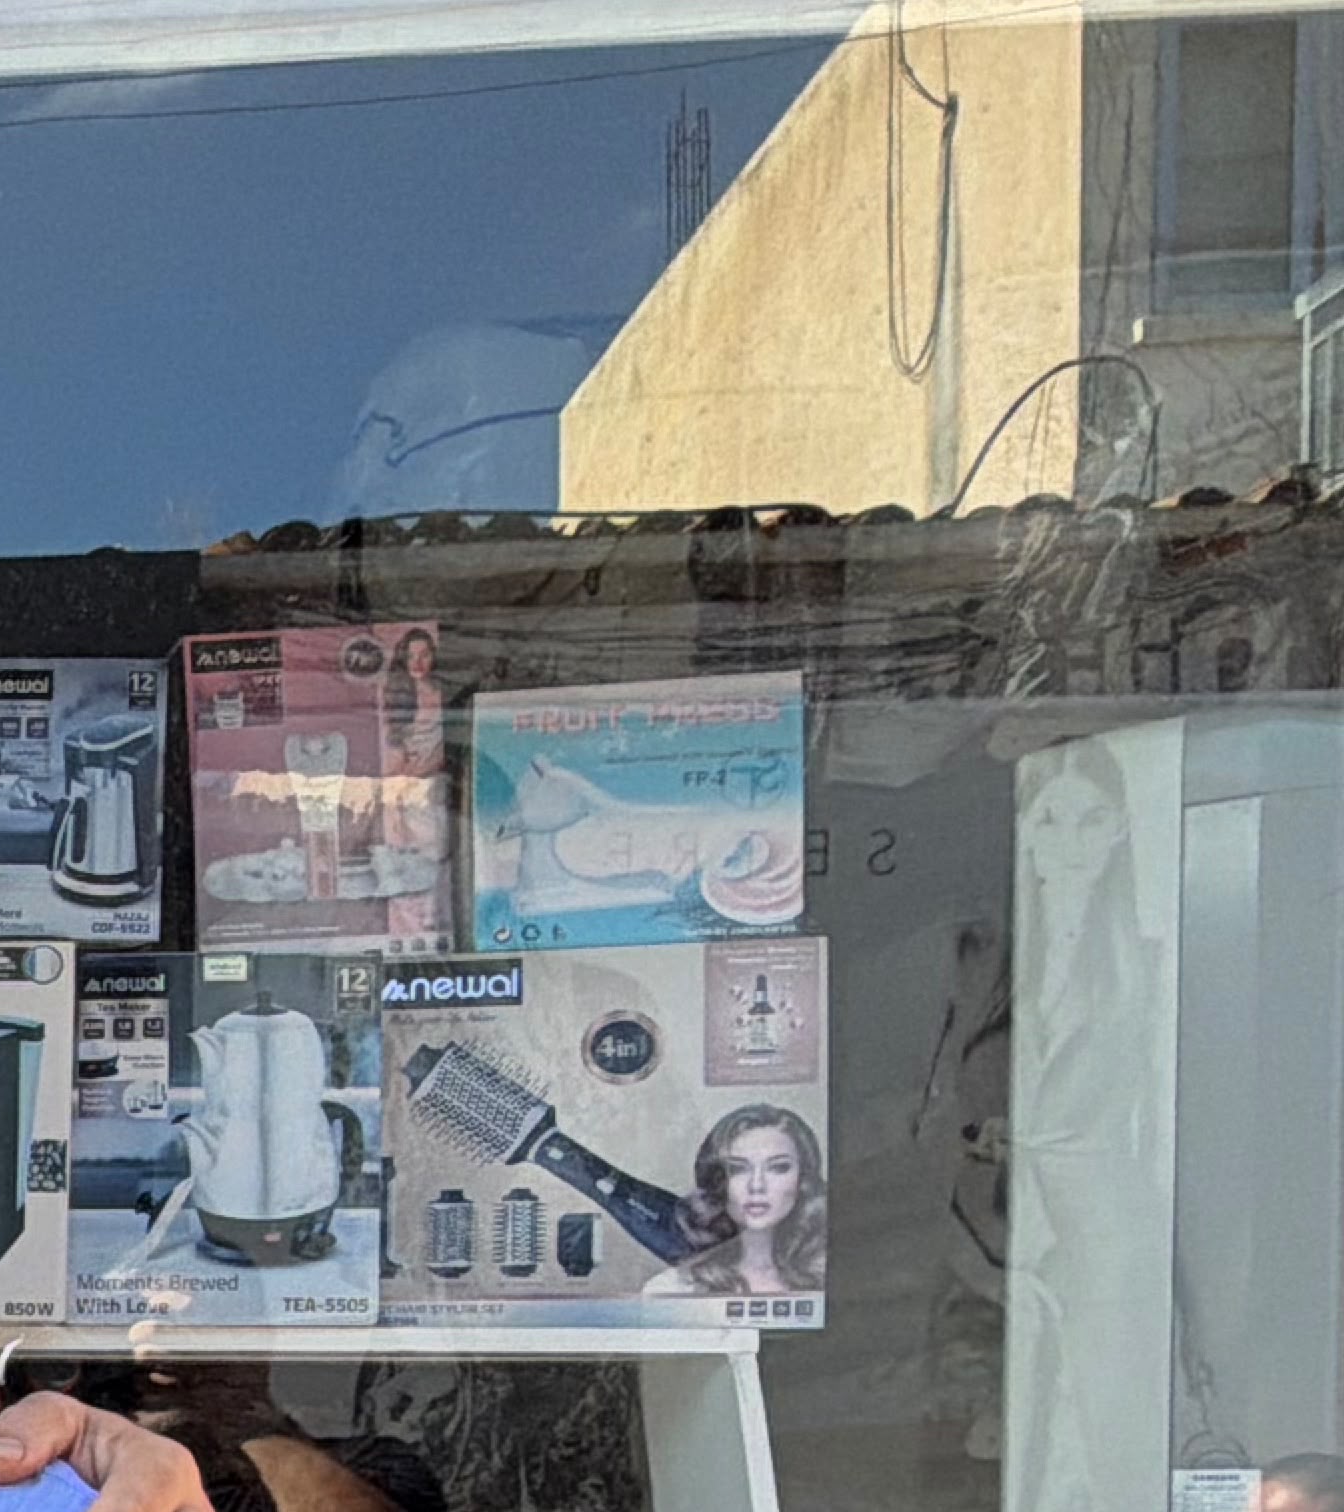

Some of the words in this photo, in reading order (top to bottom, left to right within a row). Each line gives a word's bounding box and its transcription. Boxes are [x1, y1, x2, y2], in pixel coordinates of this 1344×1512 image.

[131, 673, 154, 692] 12
[515, 705, 623, 734] FRUIT
[339, 968, 369, 992] 12
[409, 967, 519, 1000] newal
[76, 1275, 163, 1291] Moments
[168, 1274, 240, 1291] Brewed
[5, 1302, 54, 1316] 850W
[76, 1297, 121, 1314] With
[282, 1297, 370, 1313] TEA-5505
